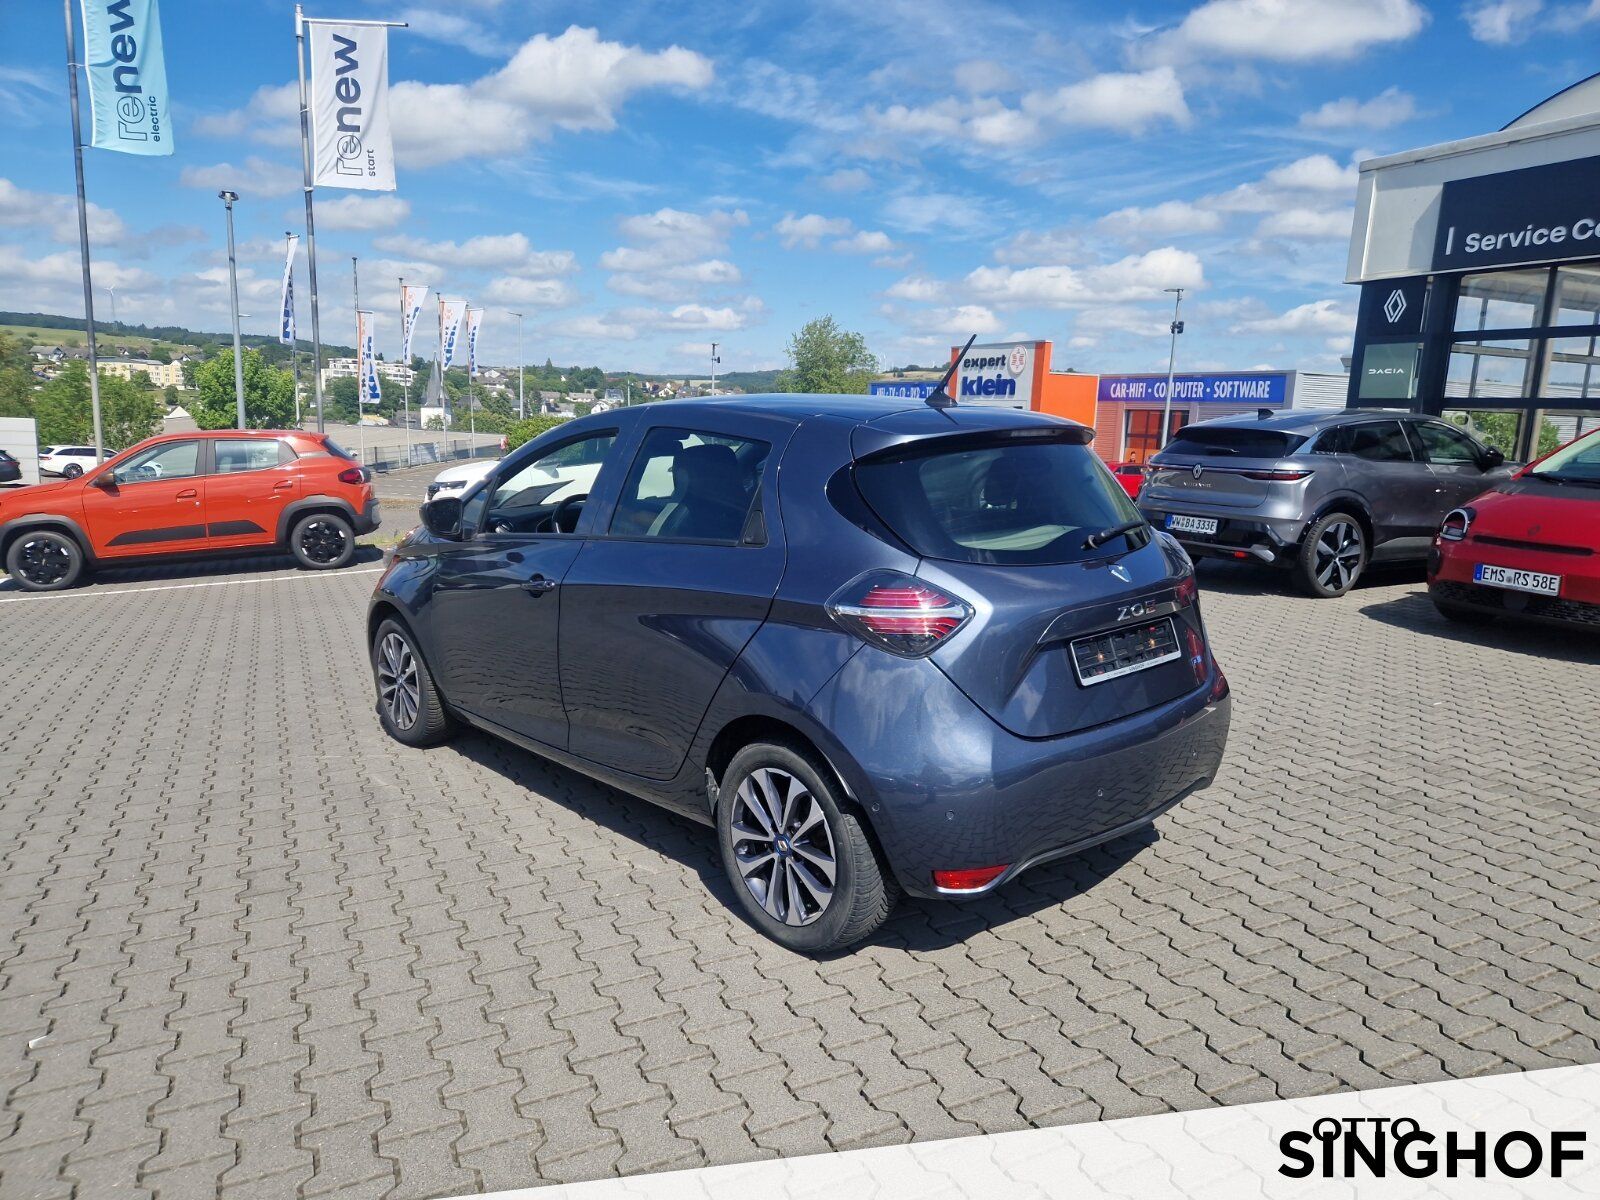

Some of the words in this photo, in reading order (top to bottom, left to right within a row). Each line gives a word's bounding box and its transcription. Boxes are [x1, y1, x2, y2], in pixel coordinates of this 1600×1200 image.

[332, 33, 363, 176] renew
[147, 95, 160, 142] electric
[367, 149, 376, 177] start
[1464, 224, 1567, 253] Service
[1571, 218, 1600, 241] C
[963, 355, 1006, 369] expert
[961, 374, 1016, 395] klein
[1110, 382, 1147, 398] CAR-HIFI
[1213, 380, 1271, 398] SOFTWARE
[1196, 519, 1216, 532] 333E
[1482, 566, 1506, 583] EMS
[1513, 572, 1530, 587] RS
[1532, 575, 1557, 591] 58E
